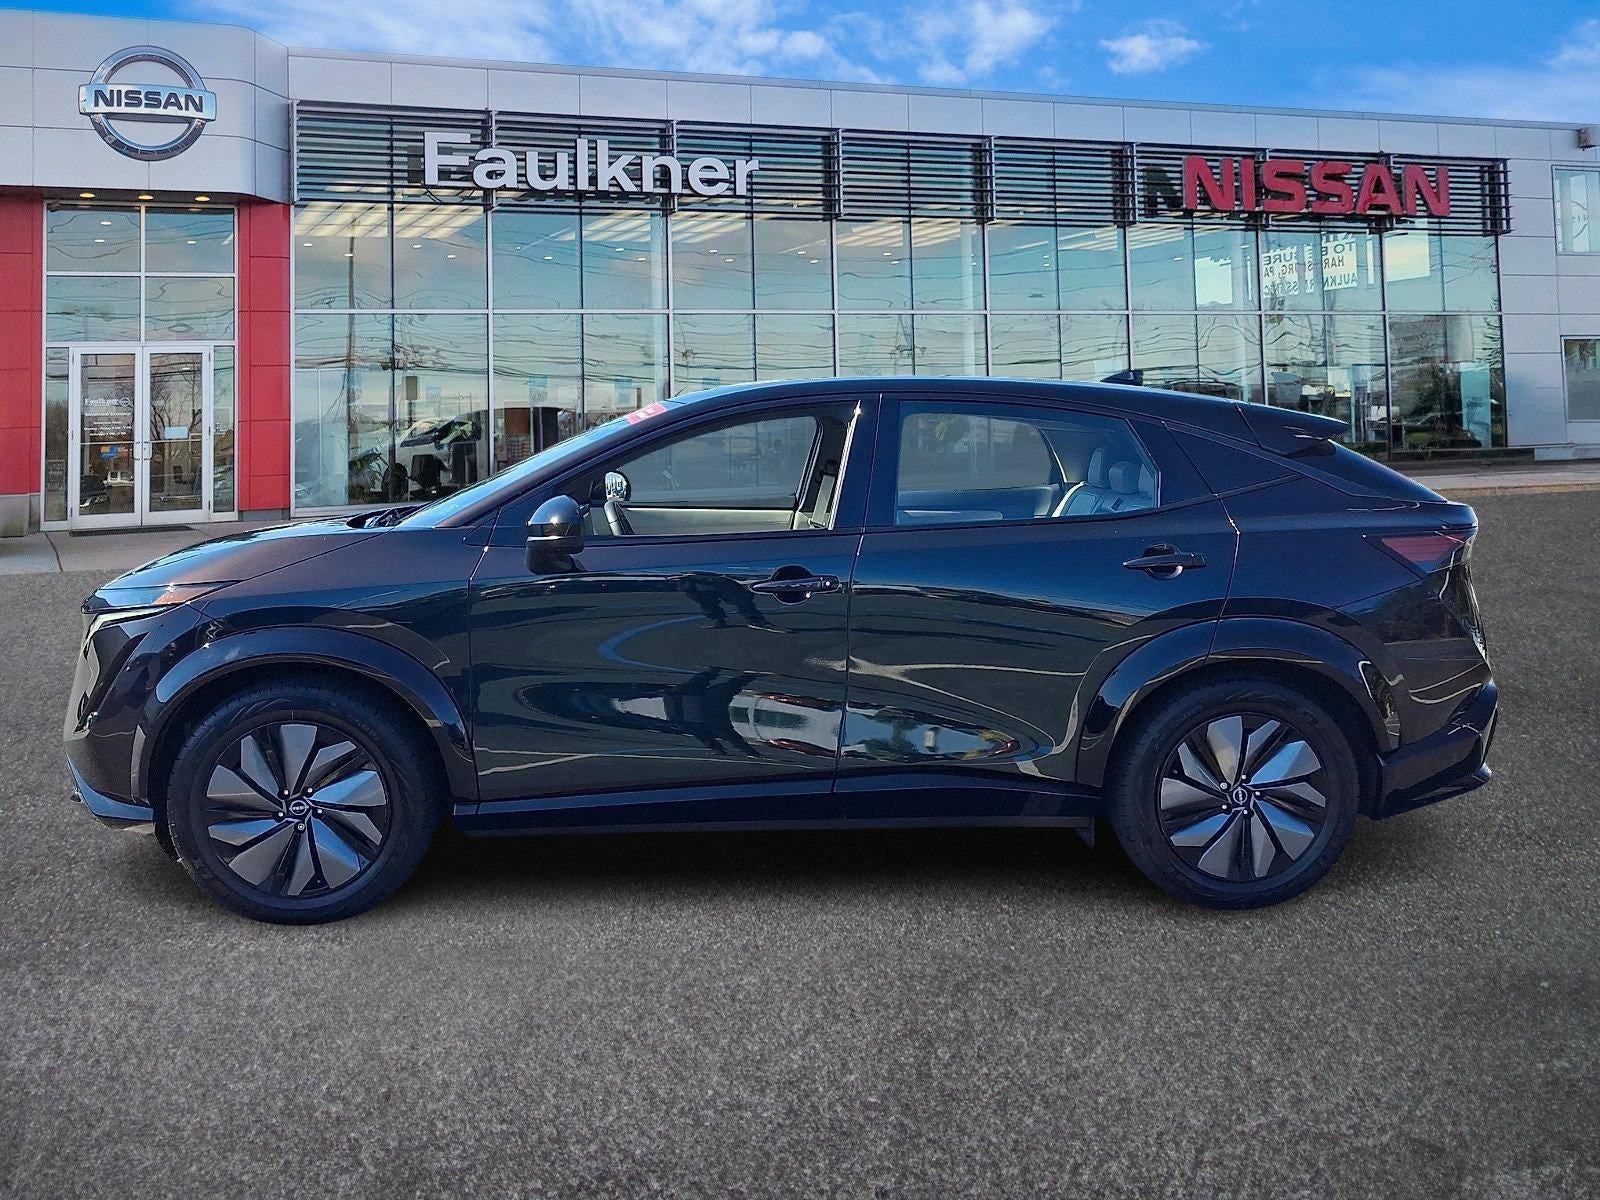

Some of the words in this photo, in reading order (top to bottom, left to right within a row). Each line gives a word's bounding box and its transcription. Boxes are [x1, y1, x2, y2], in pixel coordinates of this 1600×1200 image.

[93, 89, 204, 113] NISSAN
[423, 131, 760, 196] Faulkner
[1182, 154, 1451, 216] NISSAN
